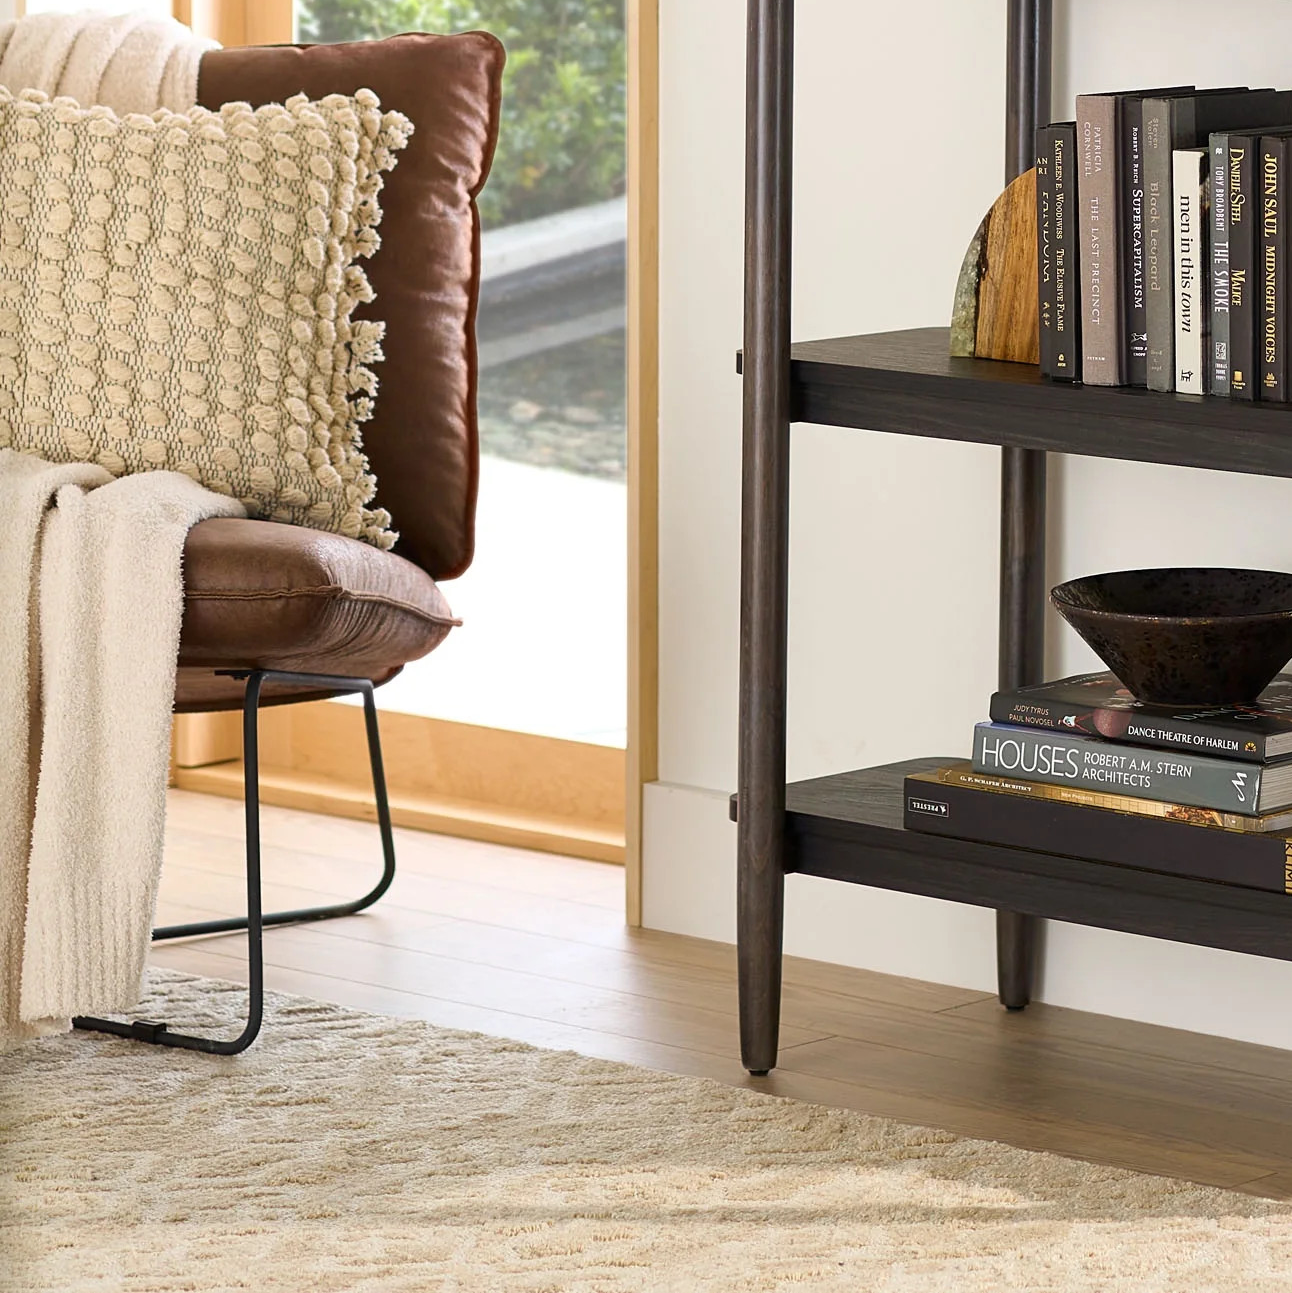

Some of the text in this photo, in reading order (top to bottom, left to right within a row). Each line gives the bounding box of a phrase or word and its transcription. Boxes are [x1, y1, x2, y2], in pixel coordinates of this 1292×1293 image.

[1055, 140, 1063, 182] KATHLEEN
[1084, 122, 1092, 177] CORNWELL
[1055, 193, 1064, 239] WOODIWISS
[1091, 197, 1099, 221] THE
[1132, 189, 1143, 308] SUPERCAPITALISM
[1148, 182, 1160, 291] Black Leopard
[1214, 166, 1229, 313] TONY BROADBENT THE SMOKE
[1056, 249, 1064, 266] THE
[1180, 196, 1194, 333] men in this town
[1264, 153, 1278, 363] JOHN SAUL MIDNIGHT VOICES
[1231, 269, 1246, 306] MALICE
[1008, 714, 1054, 727] PAUL NOVOSEL
[1014, 704, 1049, 716] JUDY TYRUS
[982, 736, 1192, 778] HOUSES ROBERT A.M. STERN
[1128, 726, 1239, 751] DANCE THEATRE OF HARLEM
[974, 778, 1000, 787] SCHAFER
[1000, 782, 1032, 792] ARCHITECT
[1082, 768, 1150, 788] ARCHITECTS
[912, 801, 939, 813] PRESTEL
